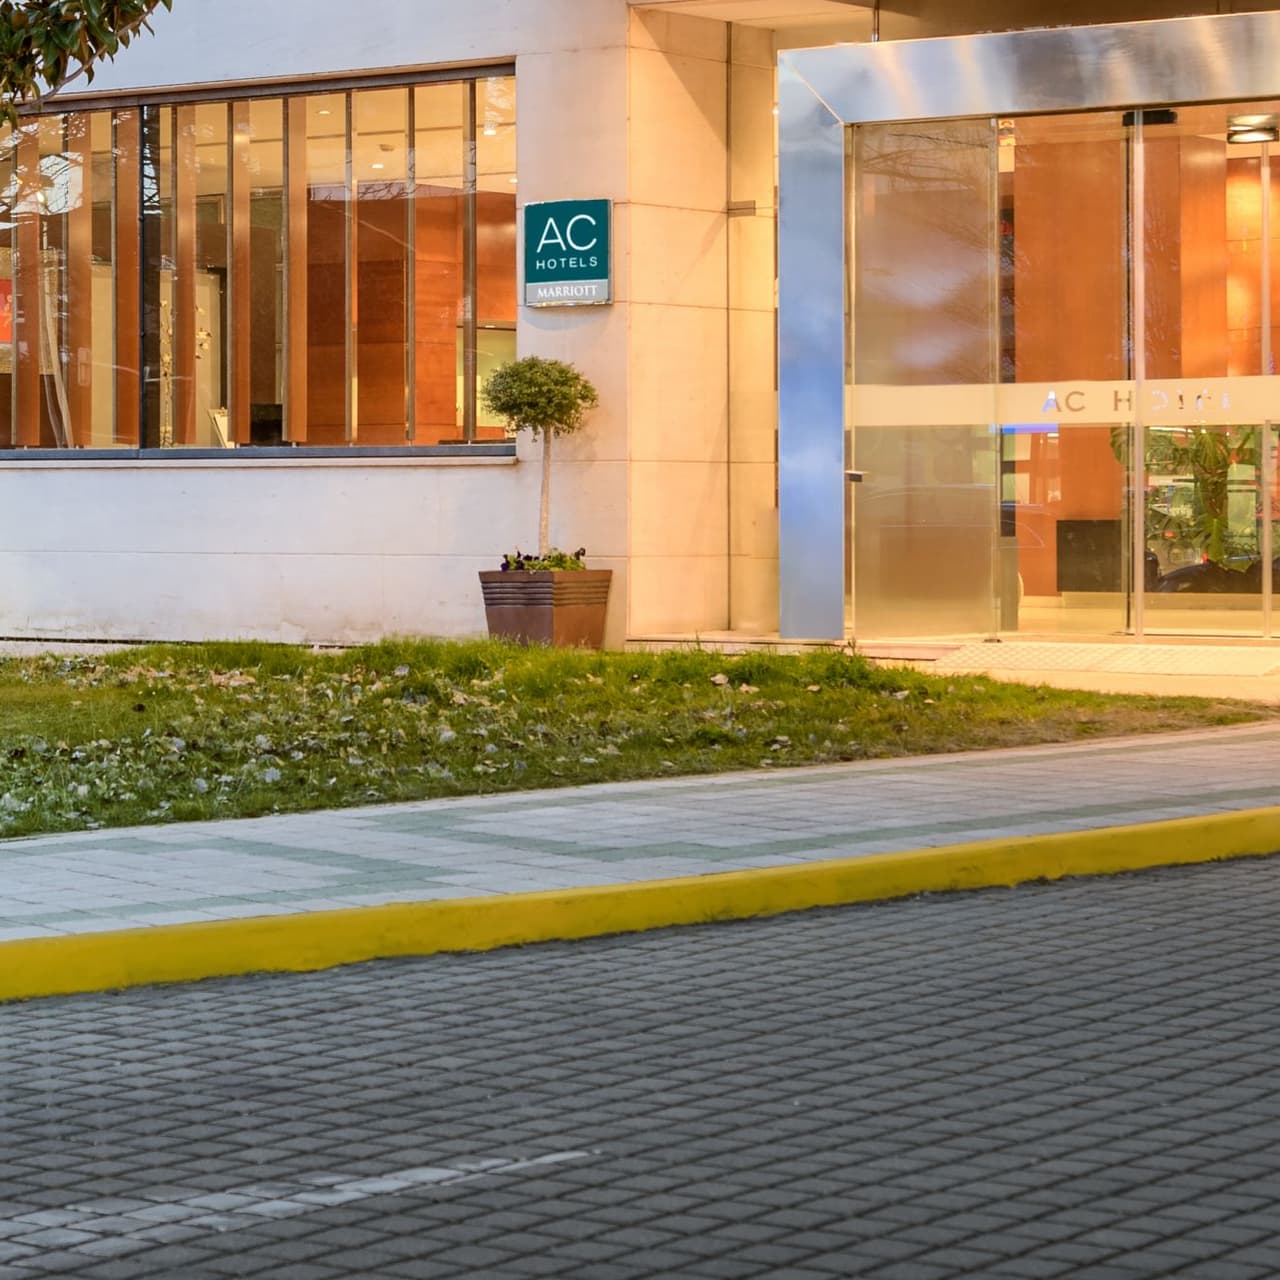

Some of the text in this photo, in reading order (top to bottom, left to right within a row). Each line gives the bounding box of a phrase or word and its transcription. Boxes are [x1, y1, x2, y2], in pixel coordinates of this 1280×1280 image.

[535, 213, 598, 254] AC
[535, 256, 599, 271] HOTELS
[536, 284, 598, 298] MARRIOTT
[1041, 390, 1086, 413] AC
